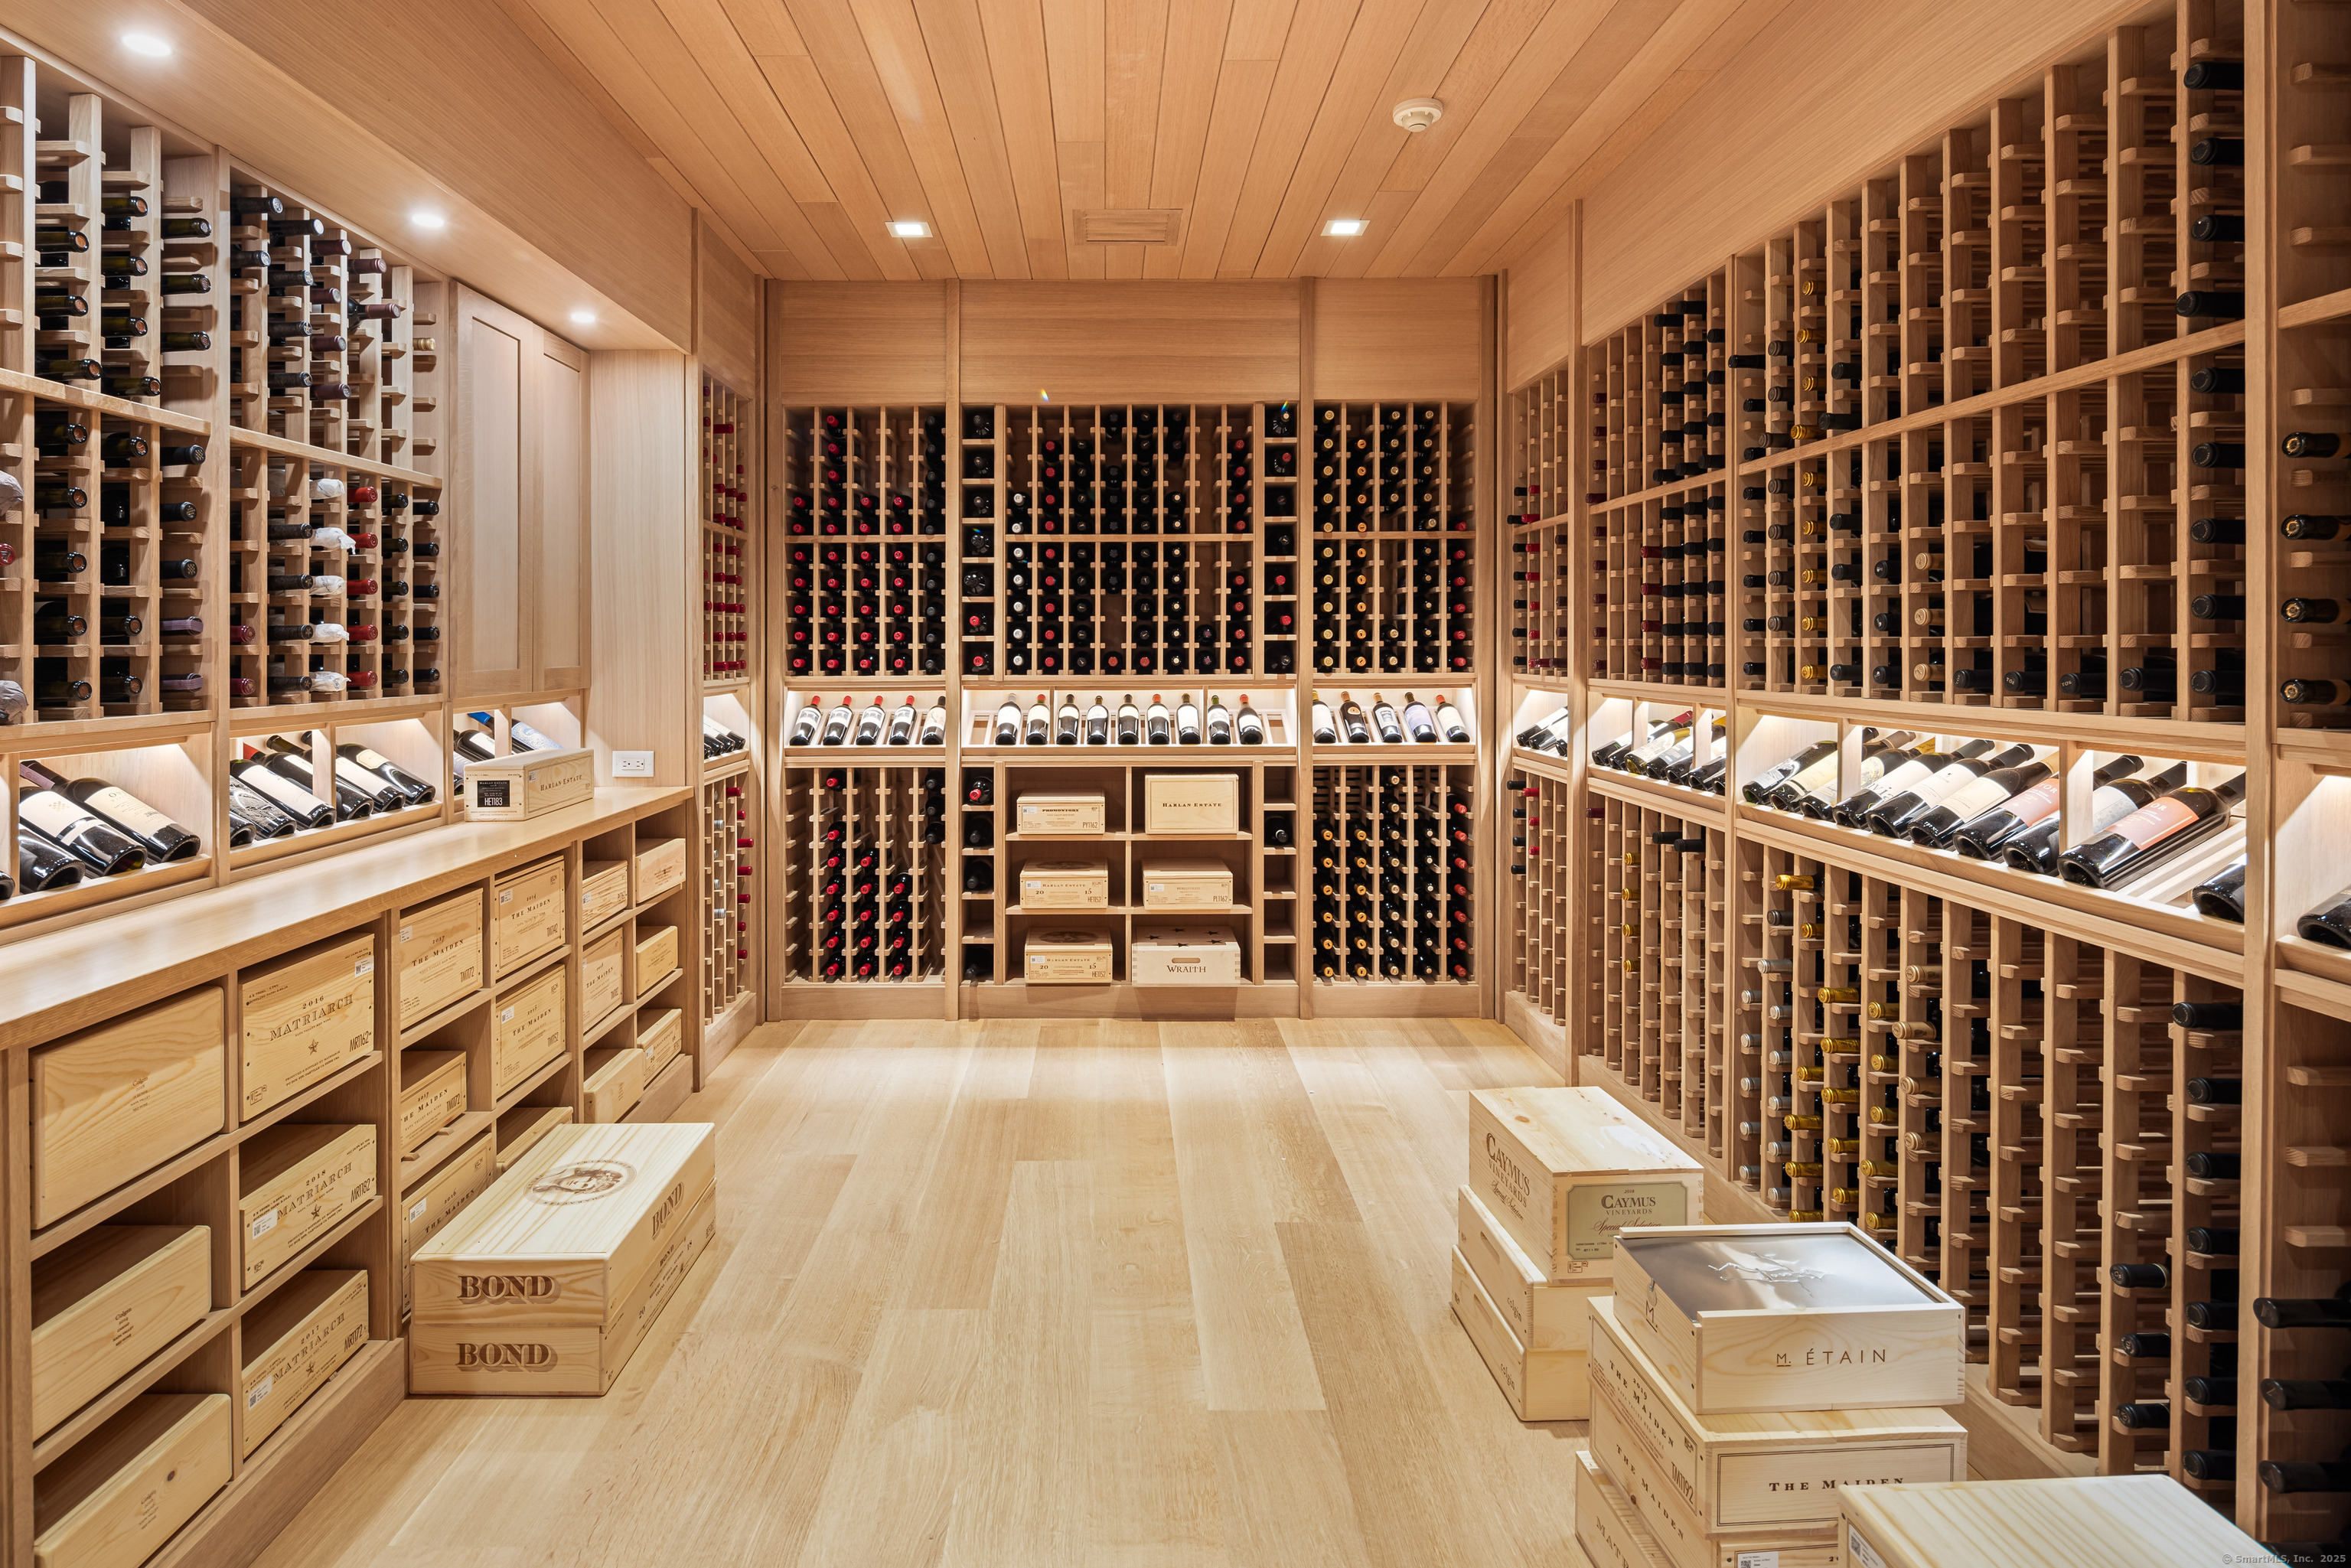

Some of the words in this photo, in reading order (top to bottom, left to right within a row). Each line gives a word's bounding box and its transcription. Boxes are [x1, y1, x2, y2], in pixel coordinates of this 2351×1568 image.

[540, 781, 561, 791] HARLAN
[562, 774, 582, 785] ESTATE
[484, 797, 503, 806] HE1183
[2150, 803, 2167, 811] OR
[511, 910, 524, 920] THE
[527, 898, 551, 913] MAIDEN
[432, 935, 445, 944] 2017
[412, 955, 429, 967] THE
[433, 939, 464, 957] MAIDEN
[460, 967, 474, 983] TM1172
[586, 979, 595, 989] THE
[597, 967, 614, 980] MAIDEN
[302, 996, 324, 1010] 2016
[269, 994, 354, 1042] MATRIARCH
[513, 1025, 526, 1037] THE
[528, 1008, 552, 1027] MAIDEN
[349, 1030, 369, 1053] MR1162
[132, 1076, 148, 1087] Colgin
[400, 1111, 414, 1123] HE
[418, 1087, 448, 1113] MAIDEN
[418, 1091, 429, 1102] 2017
[1486, 1133, 1530, 1196] CAYMUS
[305, 1169, 326, 1186] 2018
[1489, 1159, 1527, 1208] VINEYARDS
[276, 1162, 352, 1221] MATRIARCH
[444, 1188, 457, 1205] 2016
[1491, 1179, 1507, 1201] Special
[1506, 1197, 1524, 1221] Selection
[1601, 1195, 1656, 1209] CAYMUS
[425, 1217, 442, 1234] THE
[445, 1188, 475, 1218] MAIDEN
[651, 1182, 684, 1241] BOND
[1590, 1218, 1628, 1236] Special
[660, 1244, 674, 1266] BOND
[457, 1275, 562, 1306] BOND
[116, 1308, 132, 1321] Colgin
[1507, 1297, 1522, 1322] colgin
[1645, 1299, 1658, 1328] M.
[301, 1325, 320, 1345] 2017
[272, 1312, 344, 1385] MATRIARCH
[455, 1343, 558, 1373] BOND
[1776, 1353, 1792, 1364] M.
[1806, 1348, 1886, 1365] ÉTAIN
[1500, 1363, 1515, 1390] colgin
[1633, 1378, 1648, 1400] 2019
[1609, 1360, 1628, 1389] THE
[1632, 1390, 1674, 1448] MAIDEN
[1616, 1443, 1635, 1475] THE
[1642, 1478, 1684, 1540] MAIDEN
[1671, 1461, 1694, 1505] TM1192
[1769, 1482, 1809, 1491] THE
